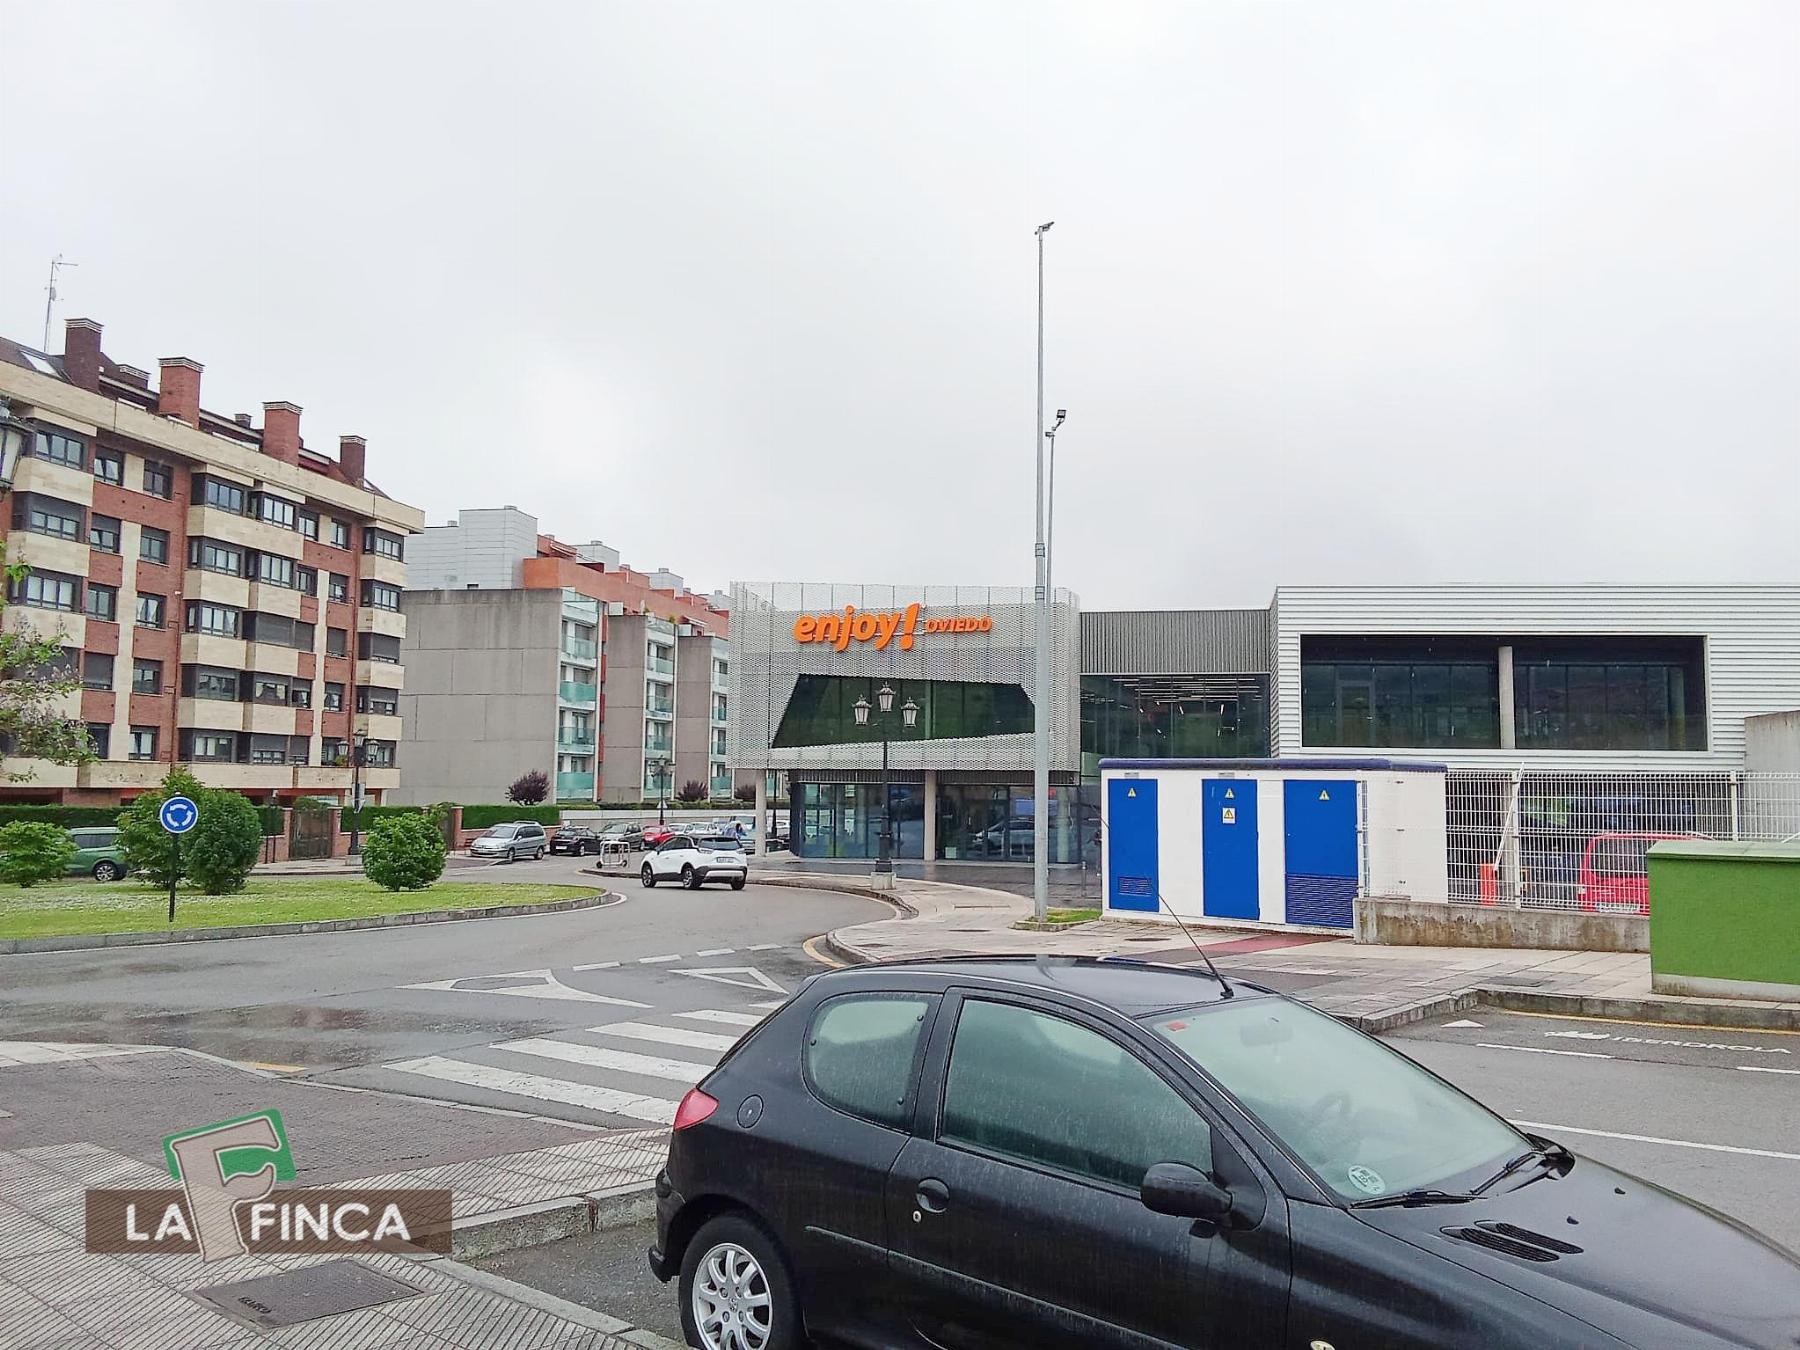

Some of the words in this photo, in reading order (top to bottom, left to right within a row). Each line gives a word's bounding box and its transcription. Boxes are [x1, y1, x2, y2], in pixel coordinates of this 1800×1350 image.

[793, 603, 920, 652] enjoy!
[925, 616, 993, 633] OVIEDO
[1611, 1036, 1792, 1055] IBERDROLA
